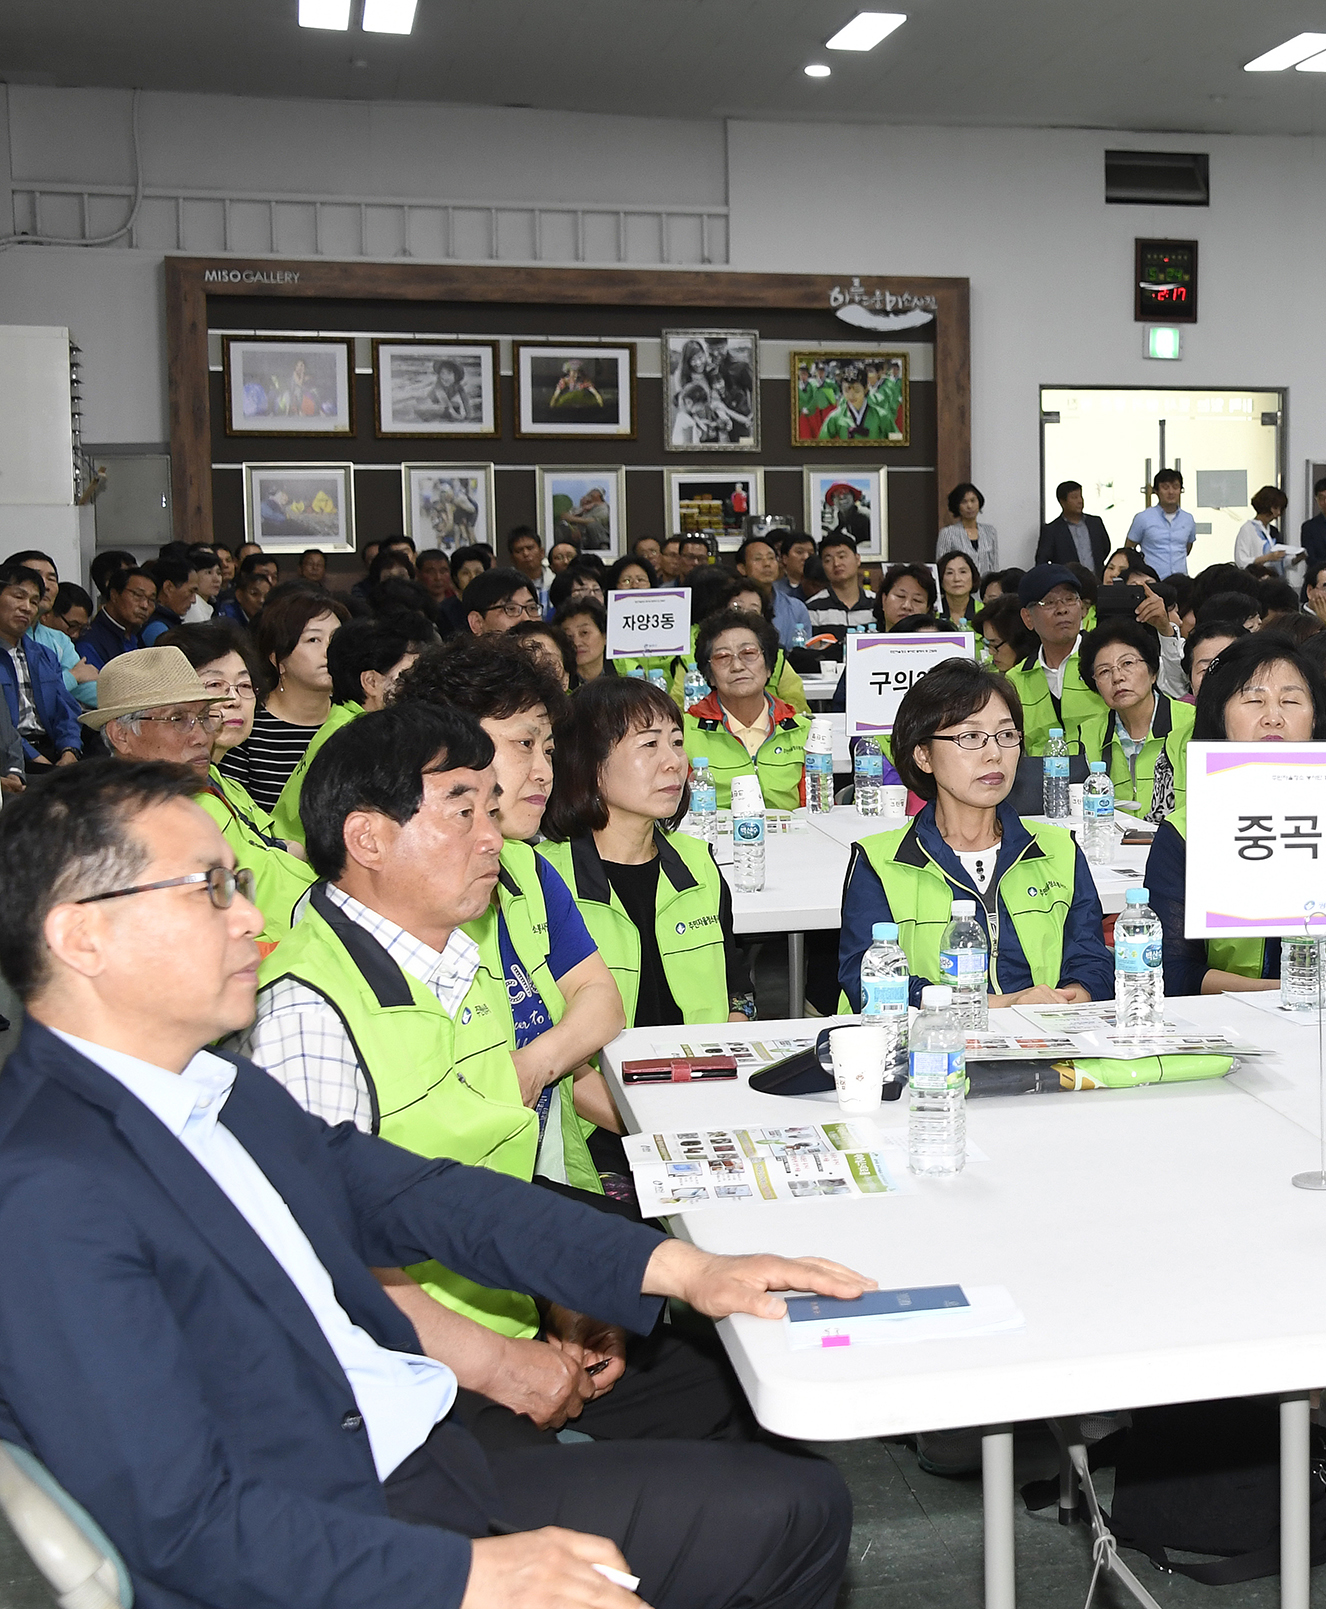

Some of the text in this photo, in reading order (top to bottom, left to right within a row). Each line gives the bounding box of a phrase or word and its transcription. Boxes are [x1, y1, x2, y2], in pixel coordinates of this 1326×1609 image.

[204, 269, 300, 284] MISO GALLERY
[622, 613, 675, 632] 자양3동
